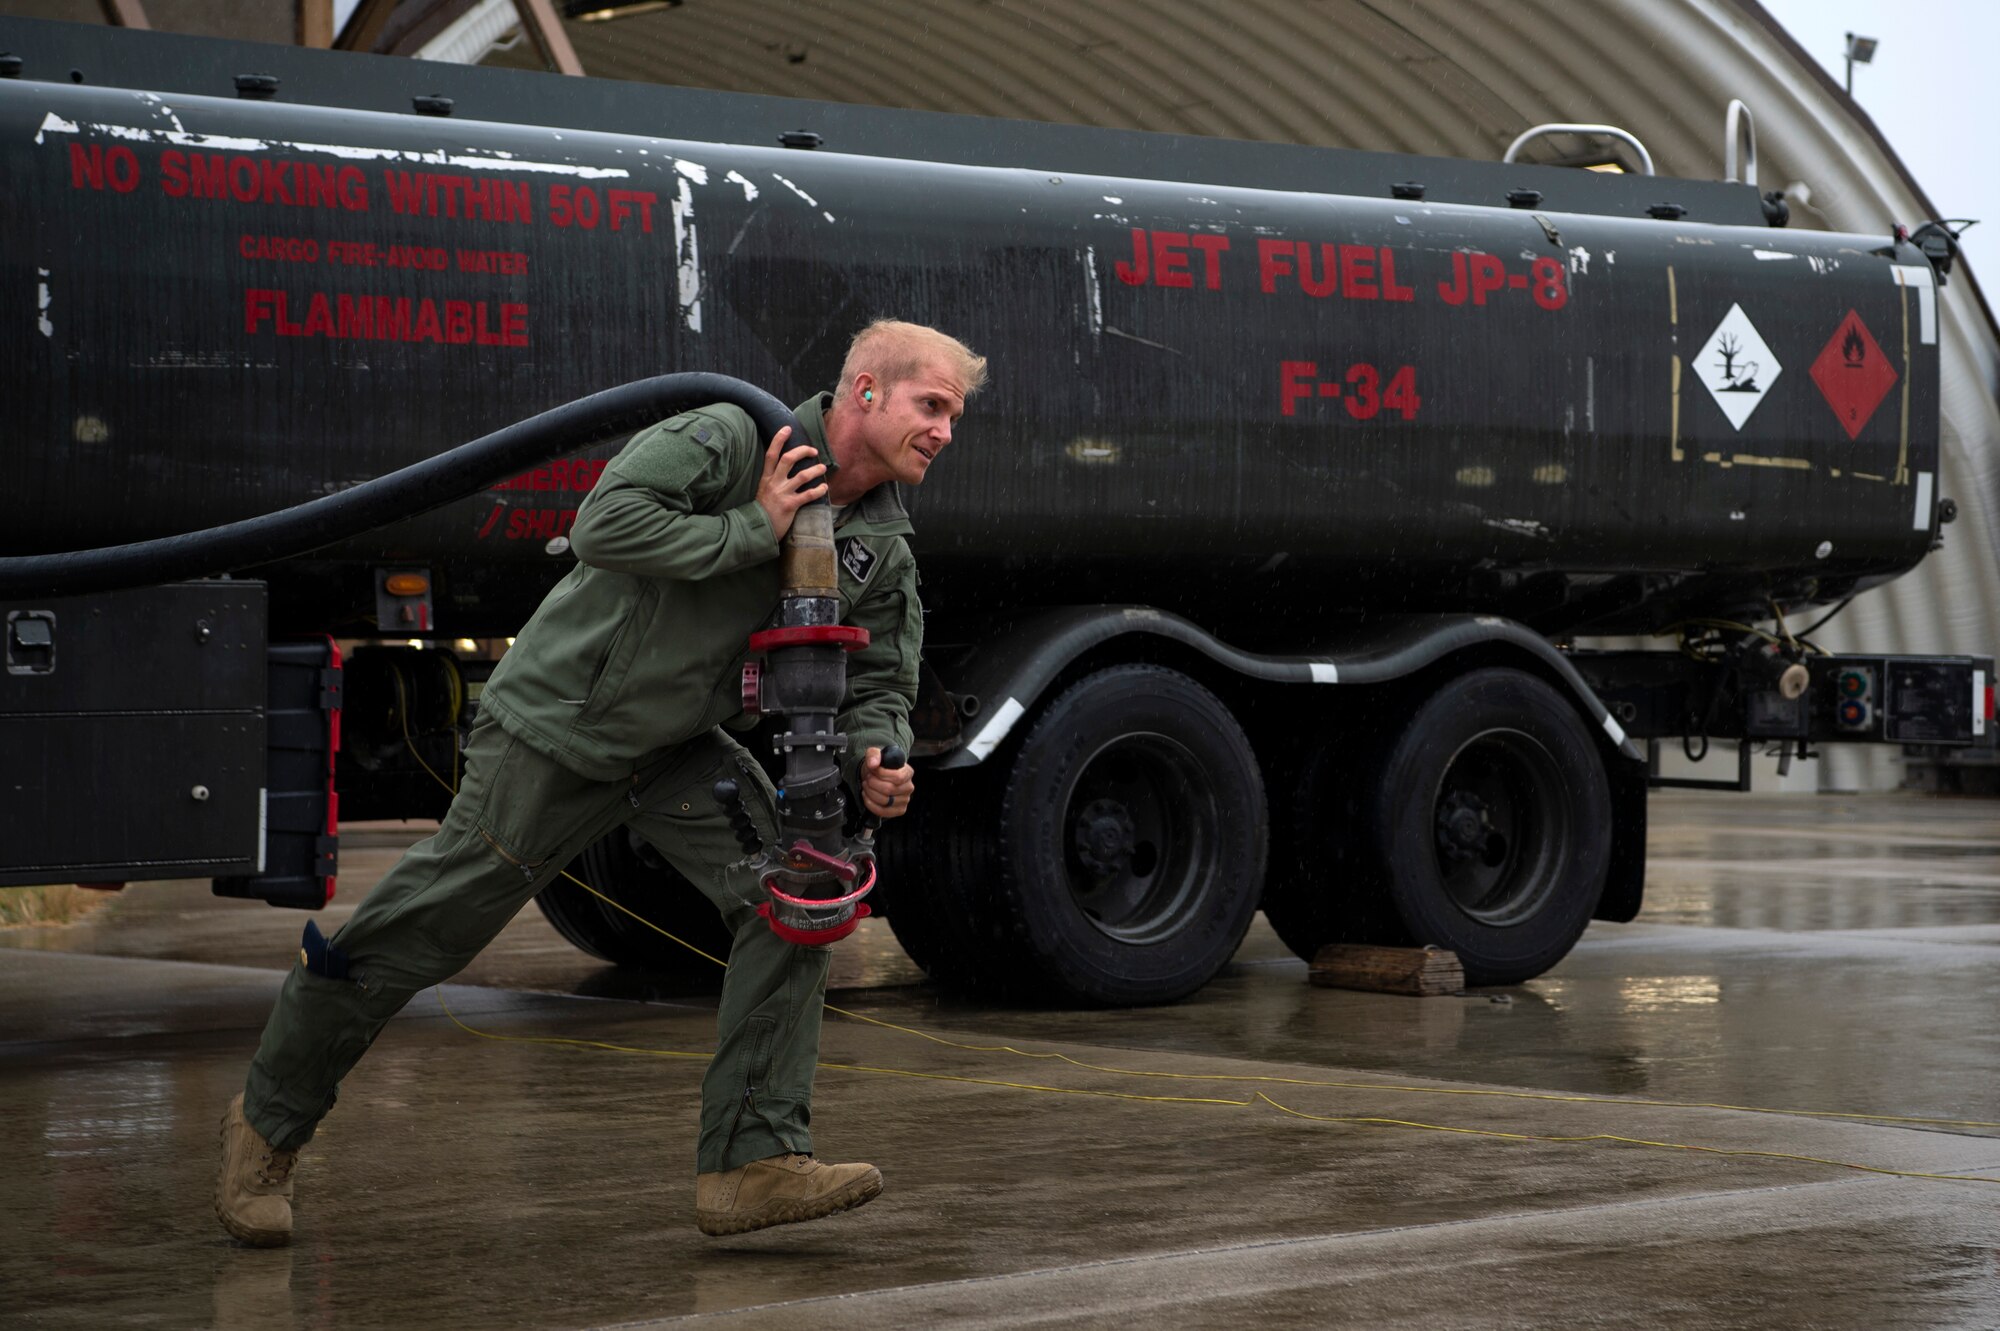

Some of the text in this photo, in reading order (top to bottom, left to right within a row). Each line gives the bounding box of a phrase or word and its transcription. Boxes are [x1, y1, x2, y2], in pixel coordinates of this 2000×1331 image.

[70, 142, 657, 233] NO SMOKING WITHIN 50 FT
[239, 235, 529, 276] CARGO FIRE-AVOID WATER
[1114, 228, 1568, 311] JET FUEL JP-8
[245, 288, 529, 347] FLAMMABLE
[1280, 360, 1421, 421] F-34
